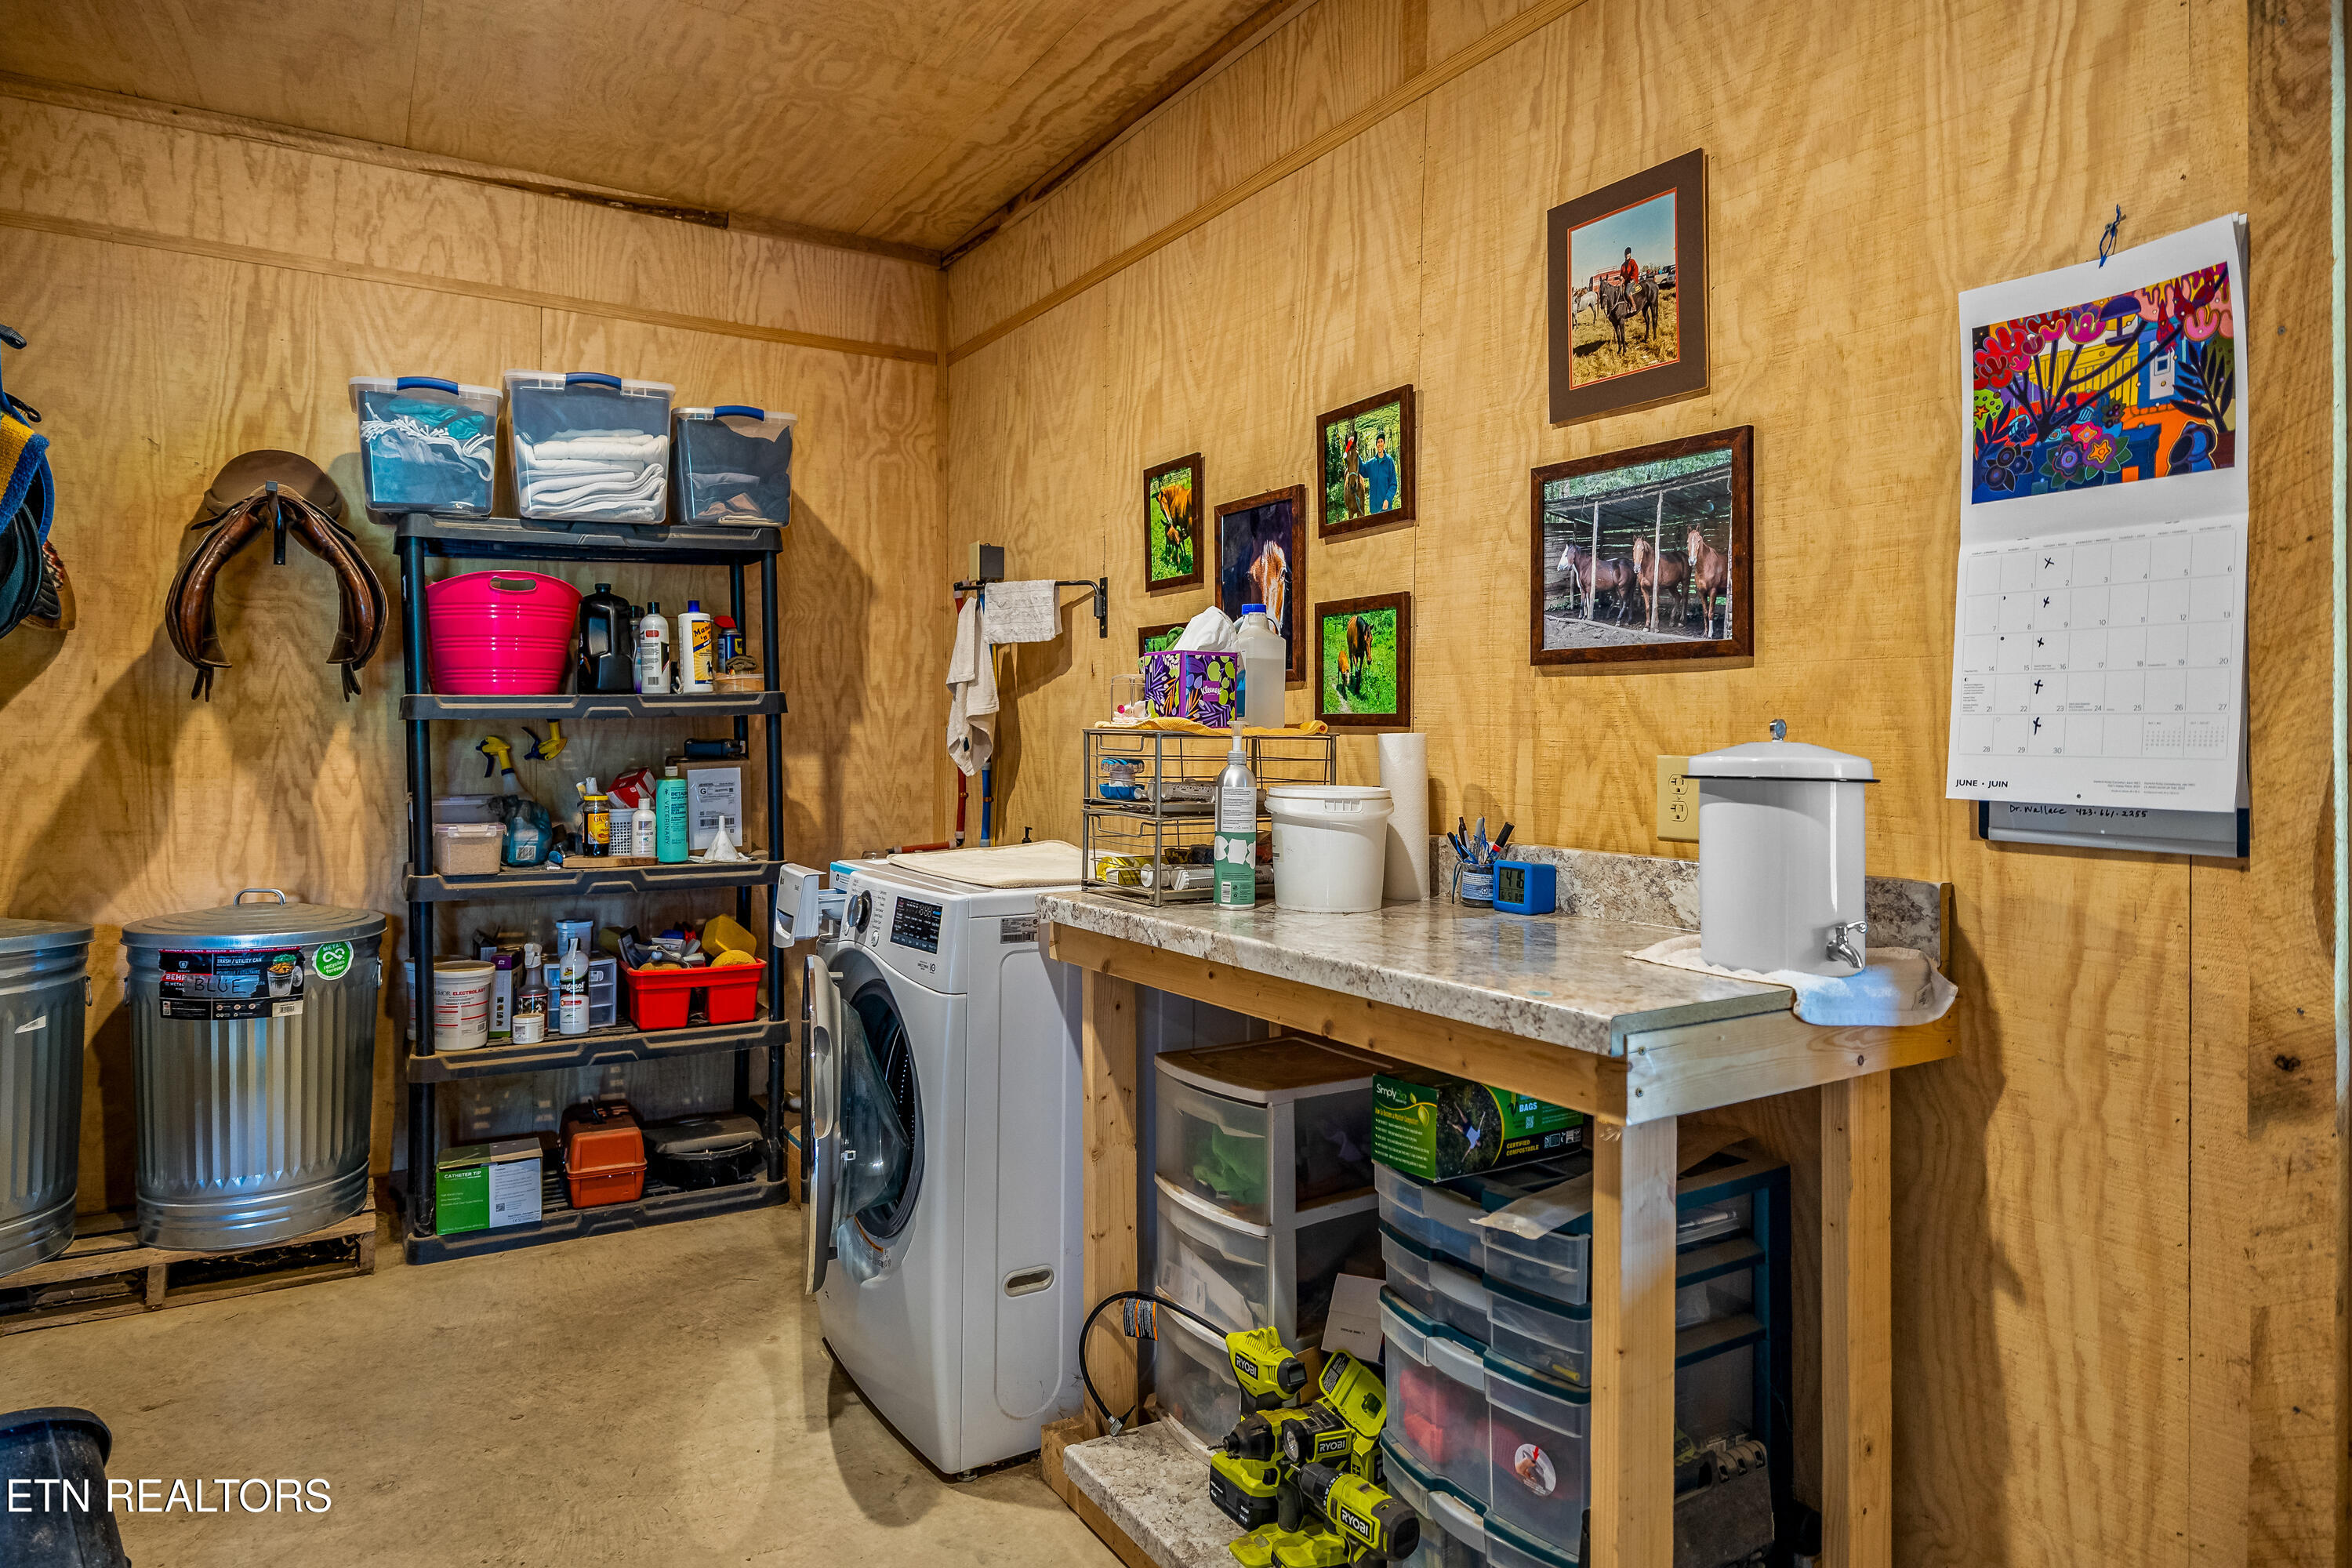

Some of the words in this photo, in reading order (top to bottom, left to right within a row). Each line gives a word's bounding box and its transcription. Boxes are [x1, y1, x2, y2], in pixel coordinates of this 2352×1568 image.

[1200, 685, 1222, 696] Kleenex
[1987, 780, 2009, 789] JUIN
[2009, 804, 2022, 813] Dr.
[2024, 805, 2067, 815] Wallace
[323, 942, 342, 952] METAL
[194, 978, 247, 994] BLUE
[1519, 1102, 1537, 1112] BAGS
[1506, 1139, 1530, 1149] CERTIFIED
[1506, 1145, 1540, 1156] COMPOSTABLE
[1236, 1356, 1257, 1377] RYOBI
[1319, 1439, 1346, 1453] RYOBI
[1341, 1508, 1370, 1537] RYOBI
